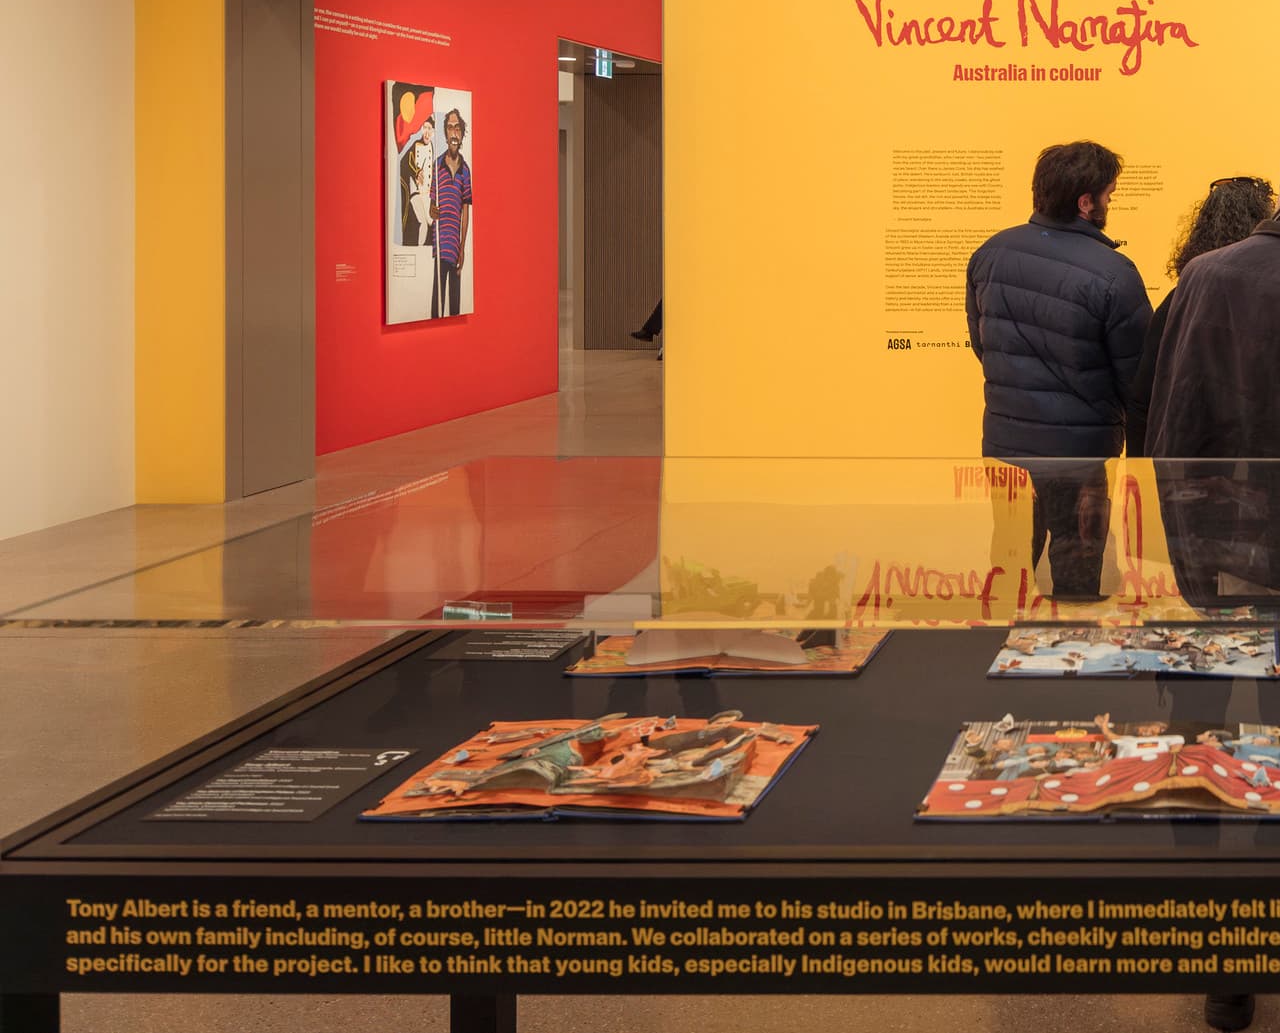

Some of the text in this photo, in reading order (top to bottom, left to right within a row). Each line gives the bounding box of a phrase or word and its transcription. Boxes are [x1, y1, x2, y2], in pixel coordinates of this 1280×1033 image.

[954, 64, 1101, 81] Australia in colour
[887, 338, 912, 350] AGSA
[916, 340, 961, 348] tarnanthi
[67, 899, 118, 920] Tony
[122, 899, 187, 917] Albert
[192, 900, 211, 918] is
[215, 904, 227, 917] a
[233, 900, 301, 920] friend,
[306, 904, 319, 918] a
[324, 902, 404, 920] mentor,
[409, 904, 421, 918] a
[550, 900, 604, 918] 2022
[609, 900, 635, 918] he
[640, 900, 713, 918] invited
[718, 904, 750, 918] me
[755, 902, 777, 918] to
[782, 900, 812, 919] his
[818, 901, 883, 919] studio
[888, 901, 907, 920] in
[912, 901, 1012, 921] Brisbane,
[1016, 900, 1083, 919] where
[1088, 900, 1094, 919] I
[1098, 899, 1227, 921] immediately
[1231, 900, 1265, 918] felt
[67, 926, 106, 944] and
[110, 926, 141, 944] his
[146, 931, 191, 945] own
[196, 927, 261, 948] family
[266, 928, 369, 949] including,
[374, 928, 396, 946] of
[400, 932, 479, 948] course,
[484, 928, 532, 946] little
[537, 928, 628, 946] Norman.
[632, 927, 666, 946] We
[670, 927, 804, 946] collaborated
[809, 932, 835, 945] on
[840, 932, 852, 946] a
[857, 927, 922, 946] series
[927, 927, 948, 946] of
[952, 926, 1023, 948] works,
[1028, 927, 1117, 949] cheekily
[1122, 927, 1203, 949] altering
